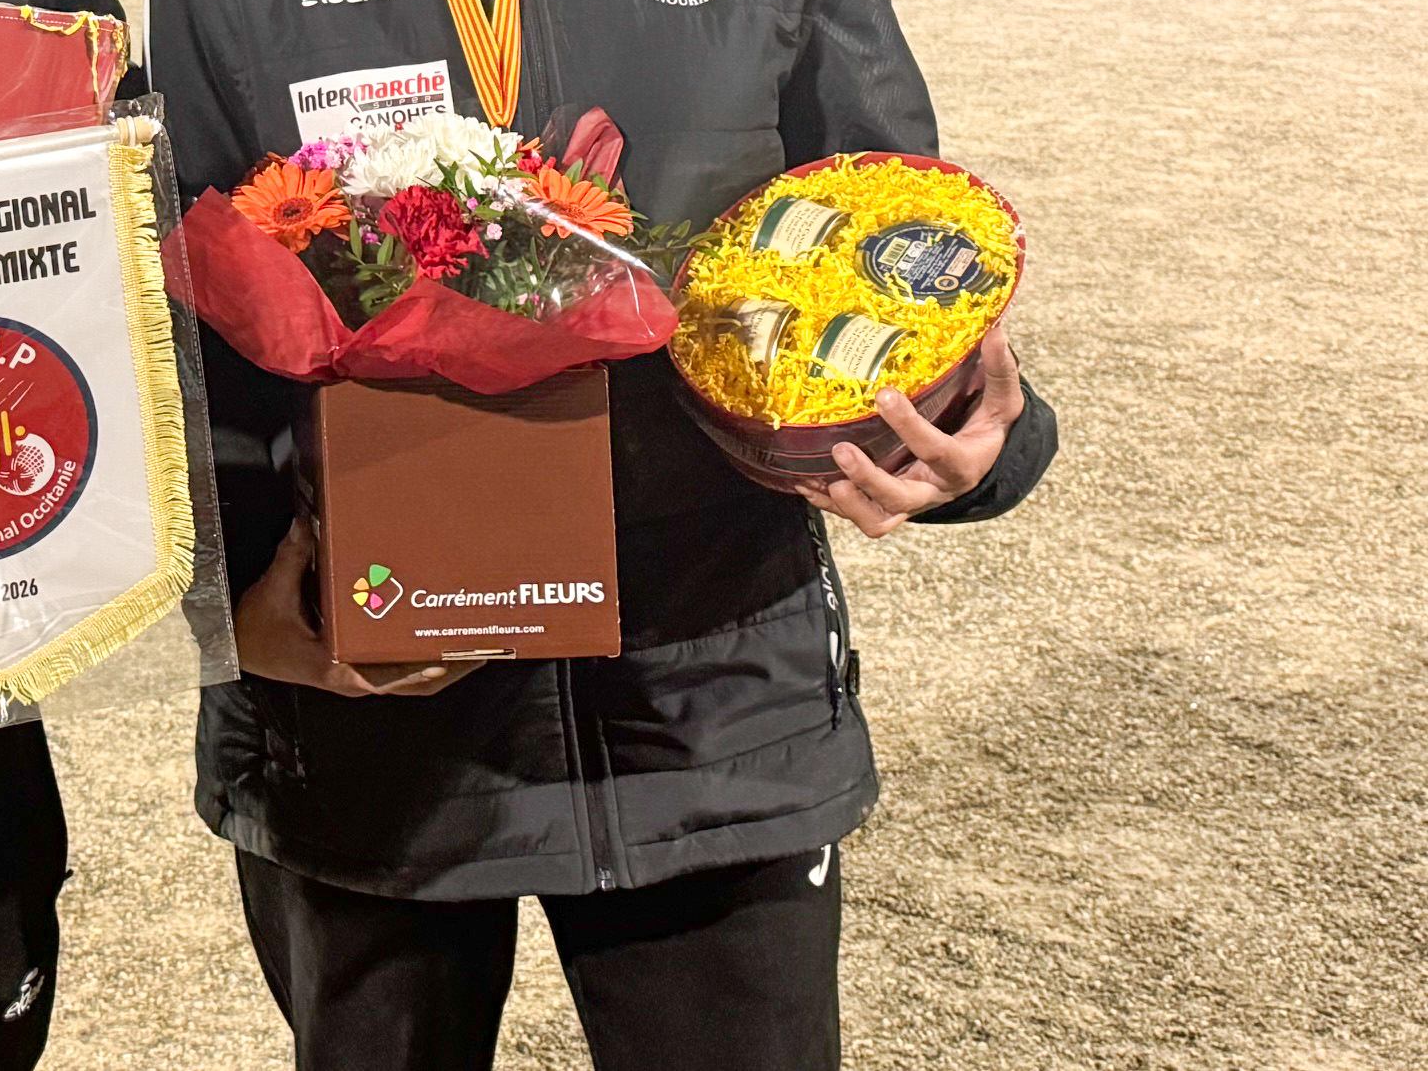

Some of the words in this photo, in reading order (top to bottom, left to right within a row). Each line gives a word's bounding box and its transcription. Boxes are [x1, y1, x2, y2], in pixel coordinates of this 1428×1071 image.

[19, 459, 77, 529] Occitanie
[1, 578, 39, 602] 2026
[410, 588, 518, 608] Carrément
[520, 582, 605, 605] FLEURS
[415, 624, 545, 637] www.carrementfleurs.com
